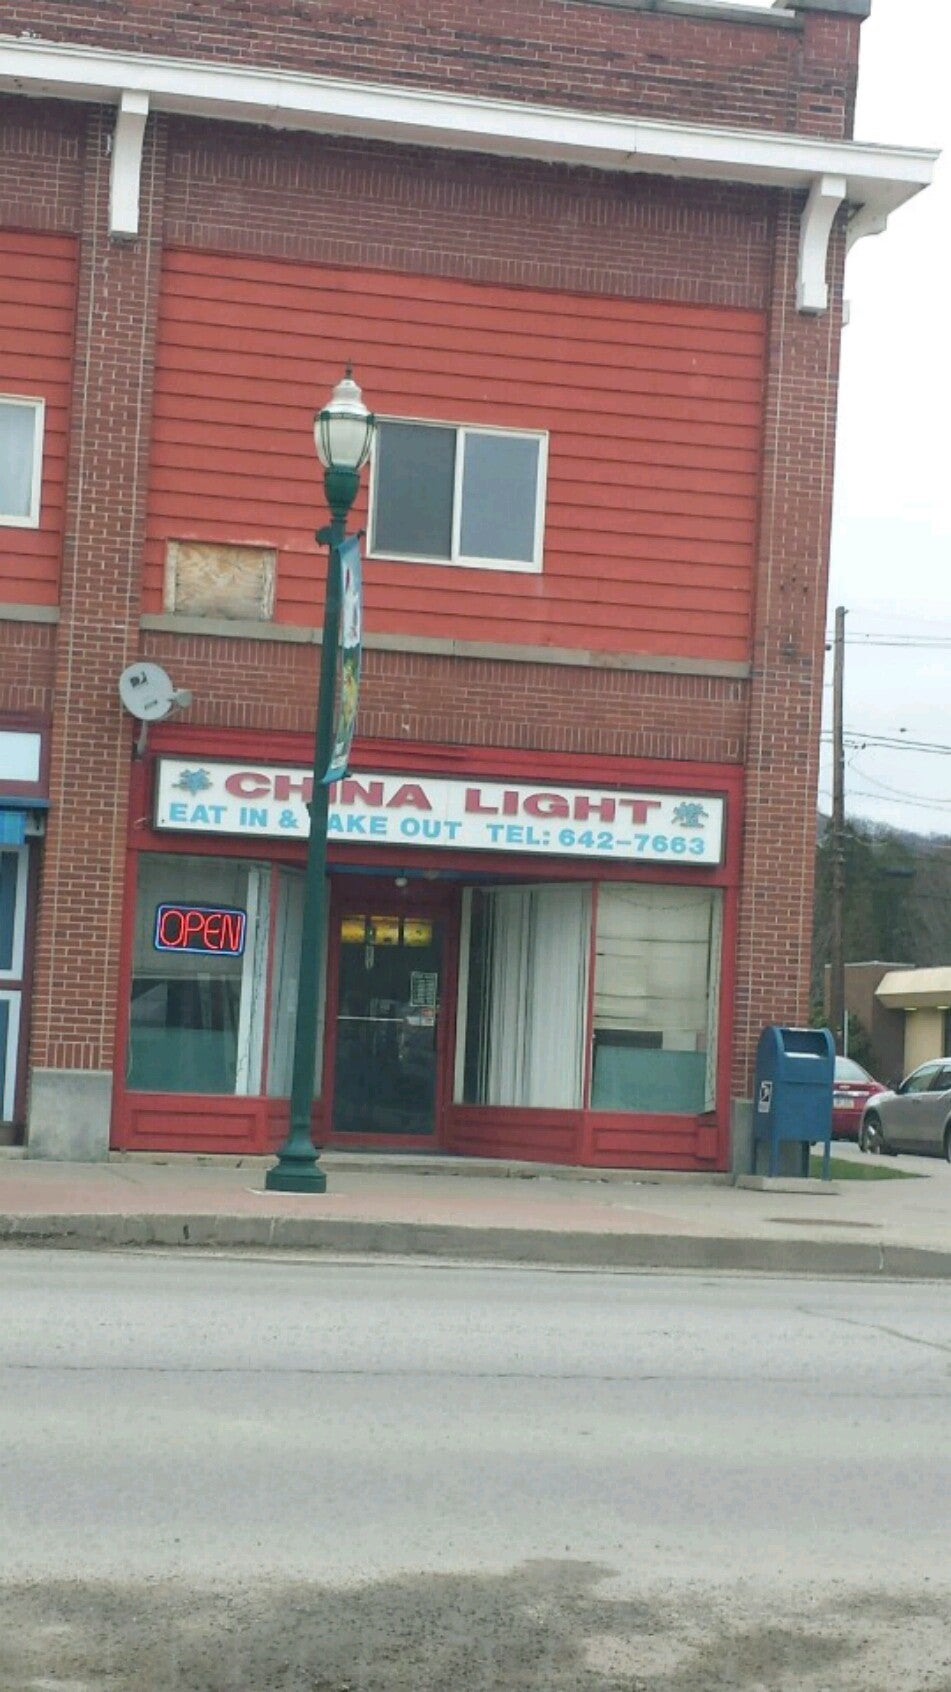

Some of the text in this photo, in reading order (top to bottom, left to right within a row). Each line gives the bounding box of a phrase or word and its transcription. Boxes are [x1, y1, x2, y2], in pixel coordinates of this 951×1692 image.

[464, 788, 662, 824] LIGHT
[168, 802, 706, 856] EAT IN & AKE OUT TEL: 642-7663
[160, 910, 241, 951] OPEN
